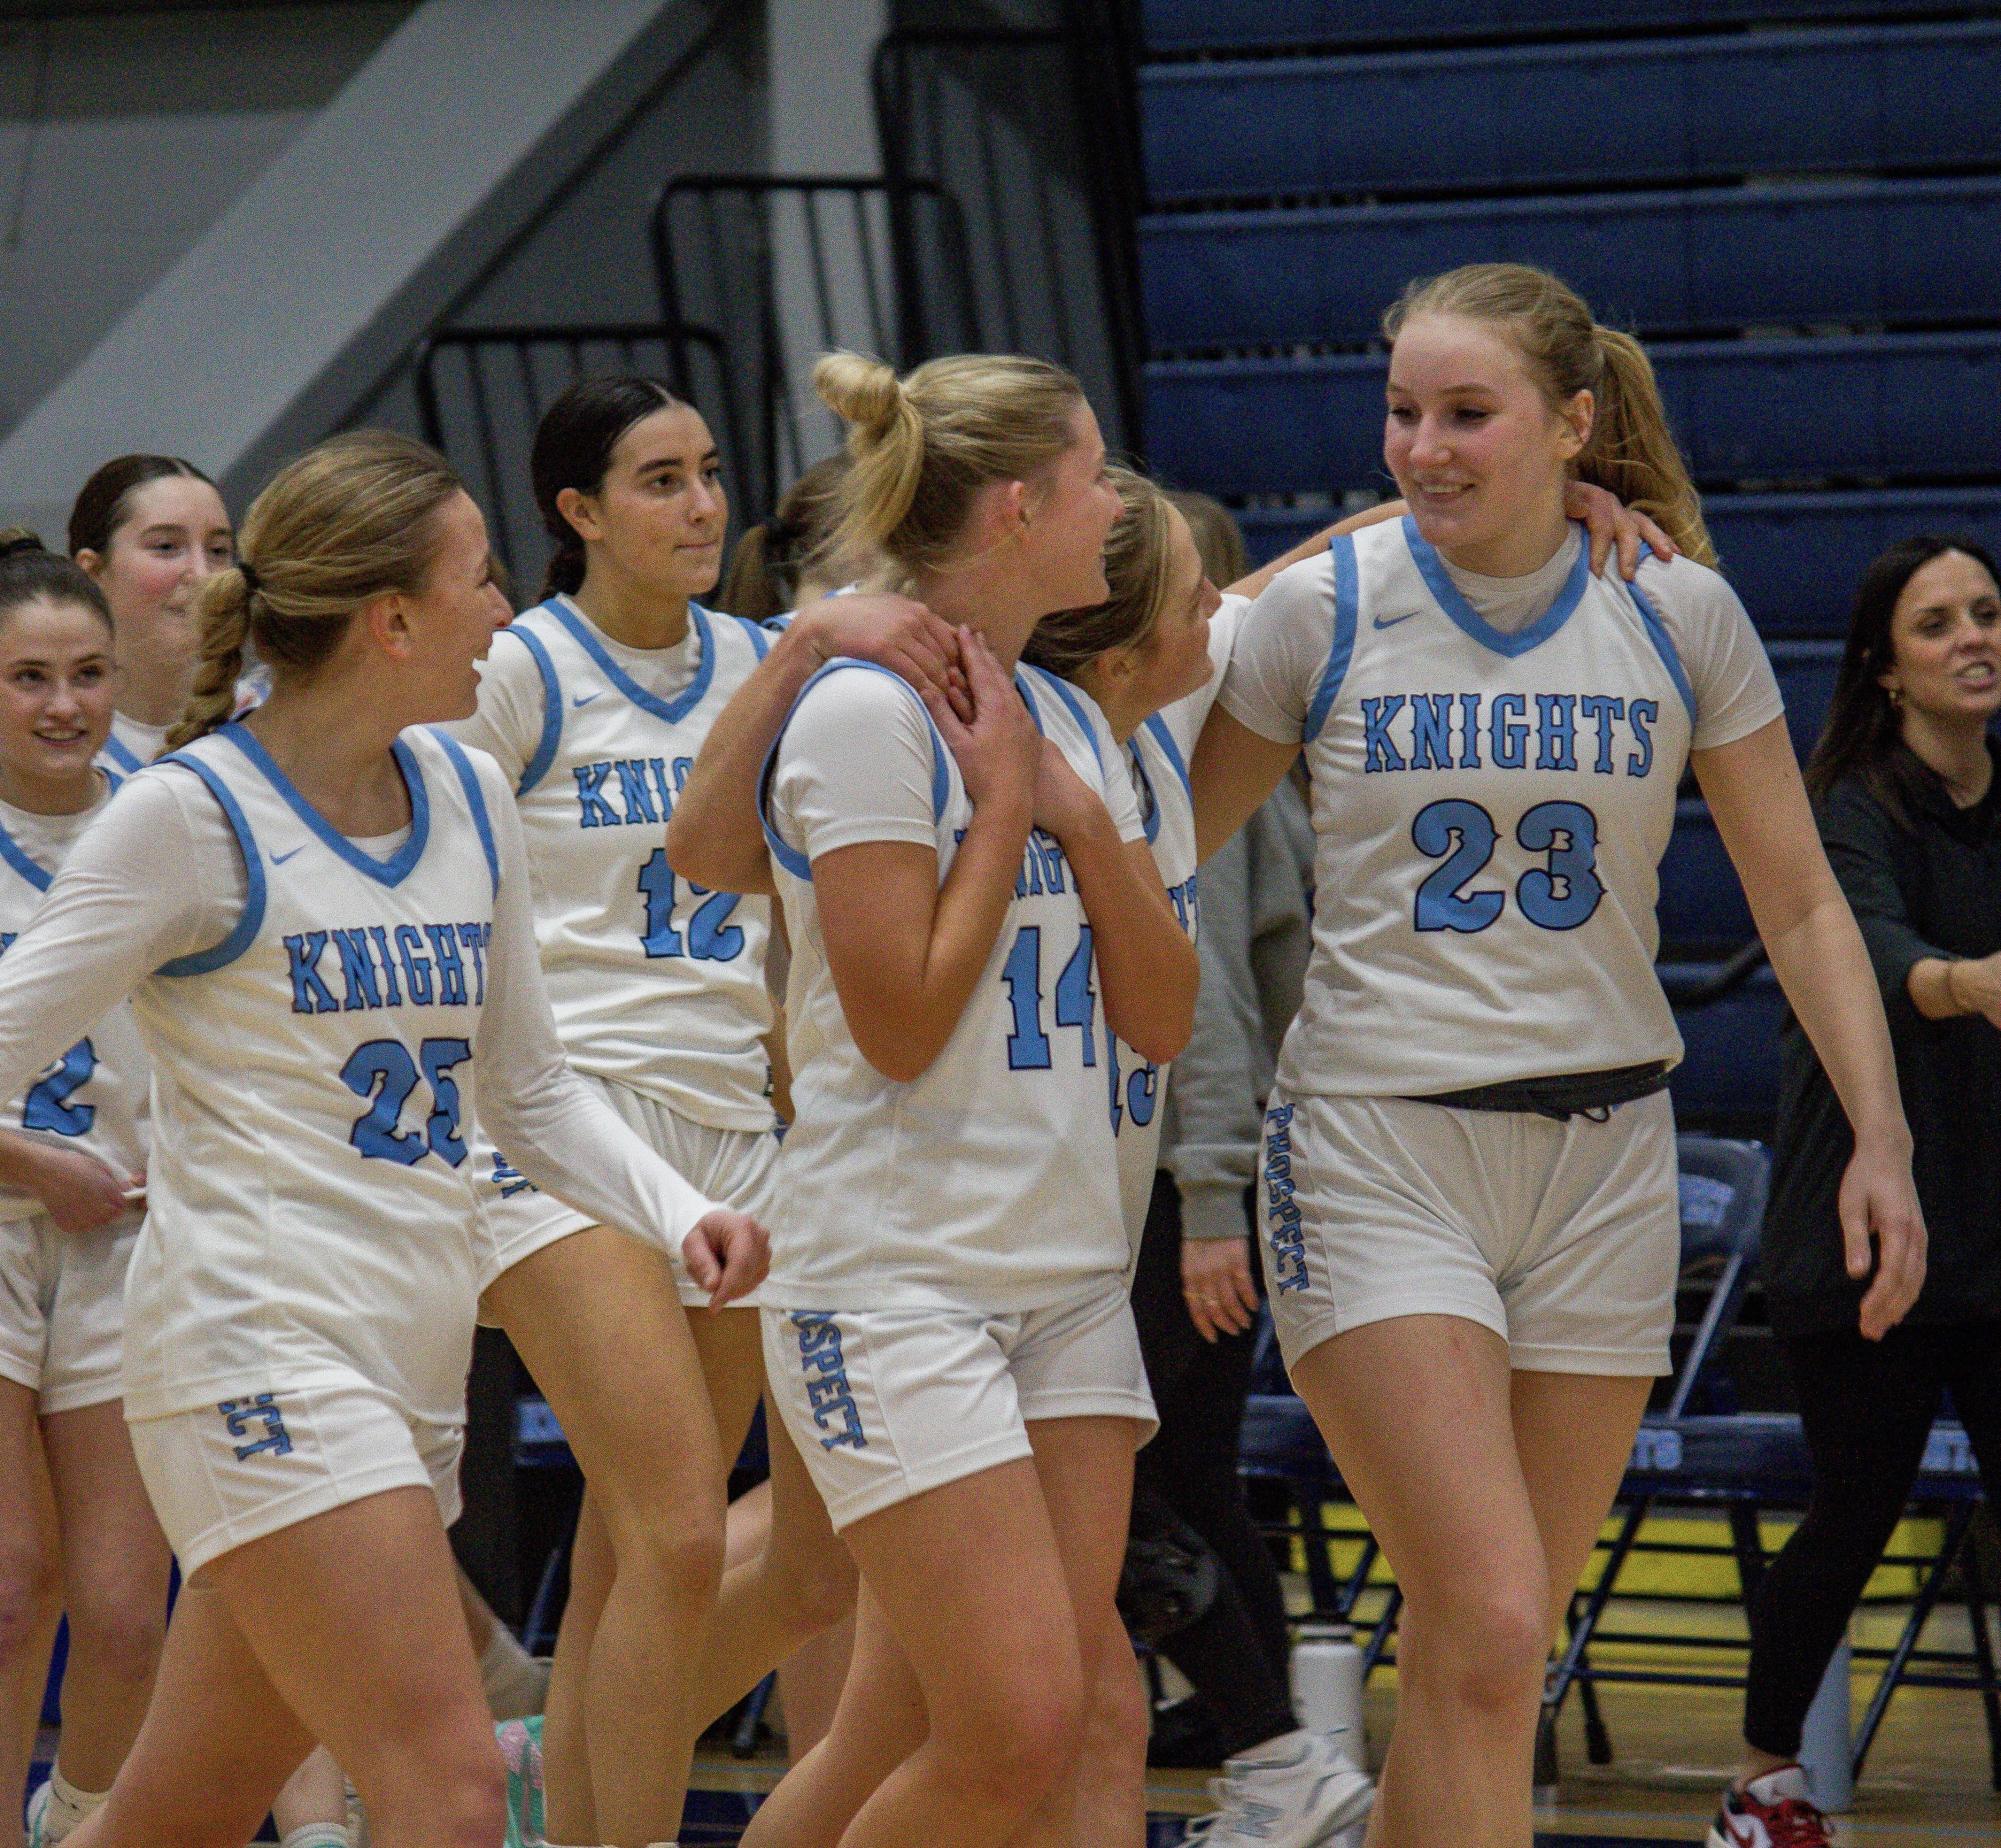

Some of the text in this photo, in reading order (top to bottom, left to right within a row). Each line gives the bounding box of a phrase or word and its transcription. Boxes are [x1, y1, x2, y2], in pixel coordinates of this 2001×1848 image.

[1361, 692, 1659, 778] KNIGHTS
[638, 848, 745, 962] 12
[1412, 798, 1608, 934] 23
[283, 922, 492, 1014] KNIGHT
[339, 1037, 472, 1168] 25
